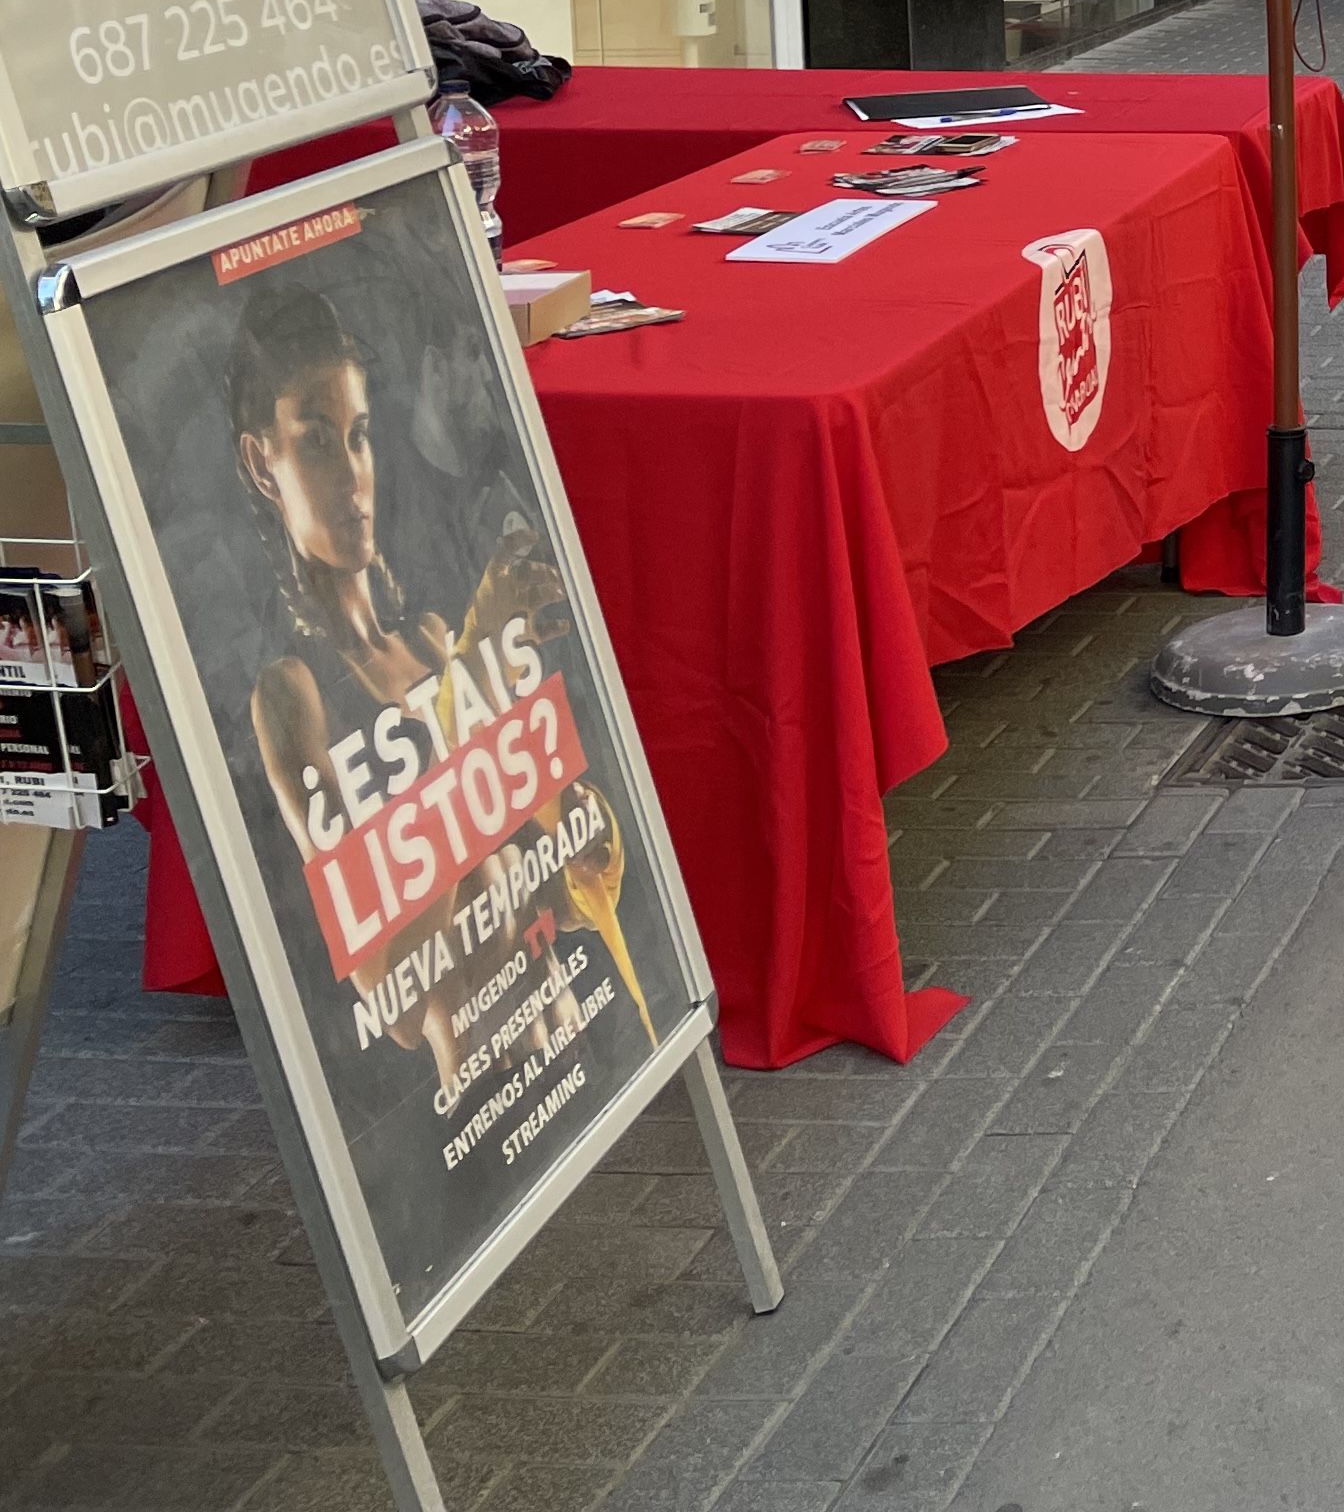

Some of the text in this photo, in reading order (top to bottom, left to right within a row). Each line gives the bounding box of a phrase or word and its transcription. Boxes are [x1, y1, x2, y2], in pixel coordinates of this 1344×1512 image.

[69, 13, 152, 86] 687
[220, 207, 355, 274] APUNTATE AHORA
[1, 743, 49, 755] PERSONAL
[302, 616, 544, 852] ¿ESTÁIS
[322, 697, 564, 956] LISTOS?
[352, 795, 607, 1051] NUEVA TEMPORADA
[433, 945, 589, 1117] CLASES PRESENCIALES
[450, 950, 527, 1038] MUGENDO
[442, 976, 616, 1171] ENTRENOS AL AIRE LIBRE
[502, 1063, 587, 1165] STREAMING
